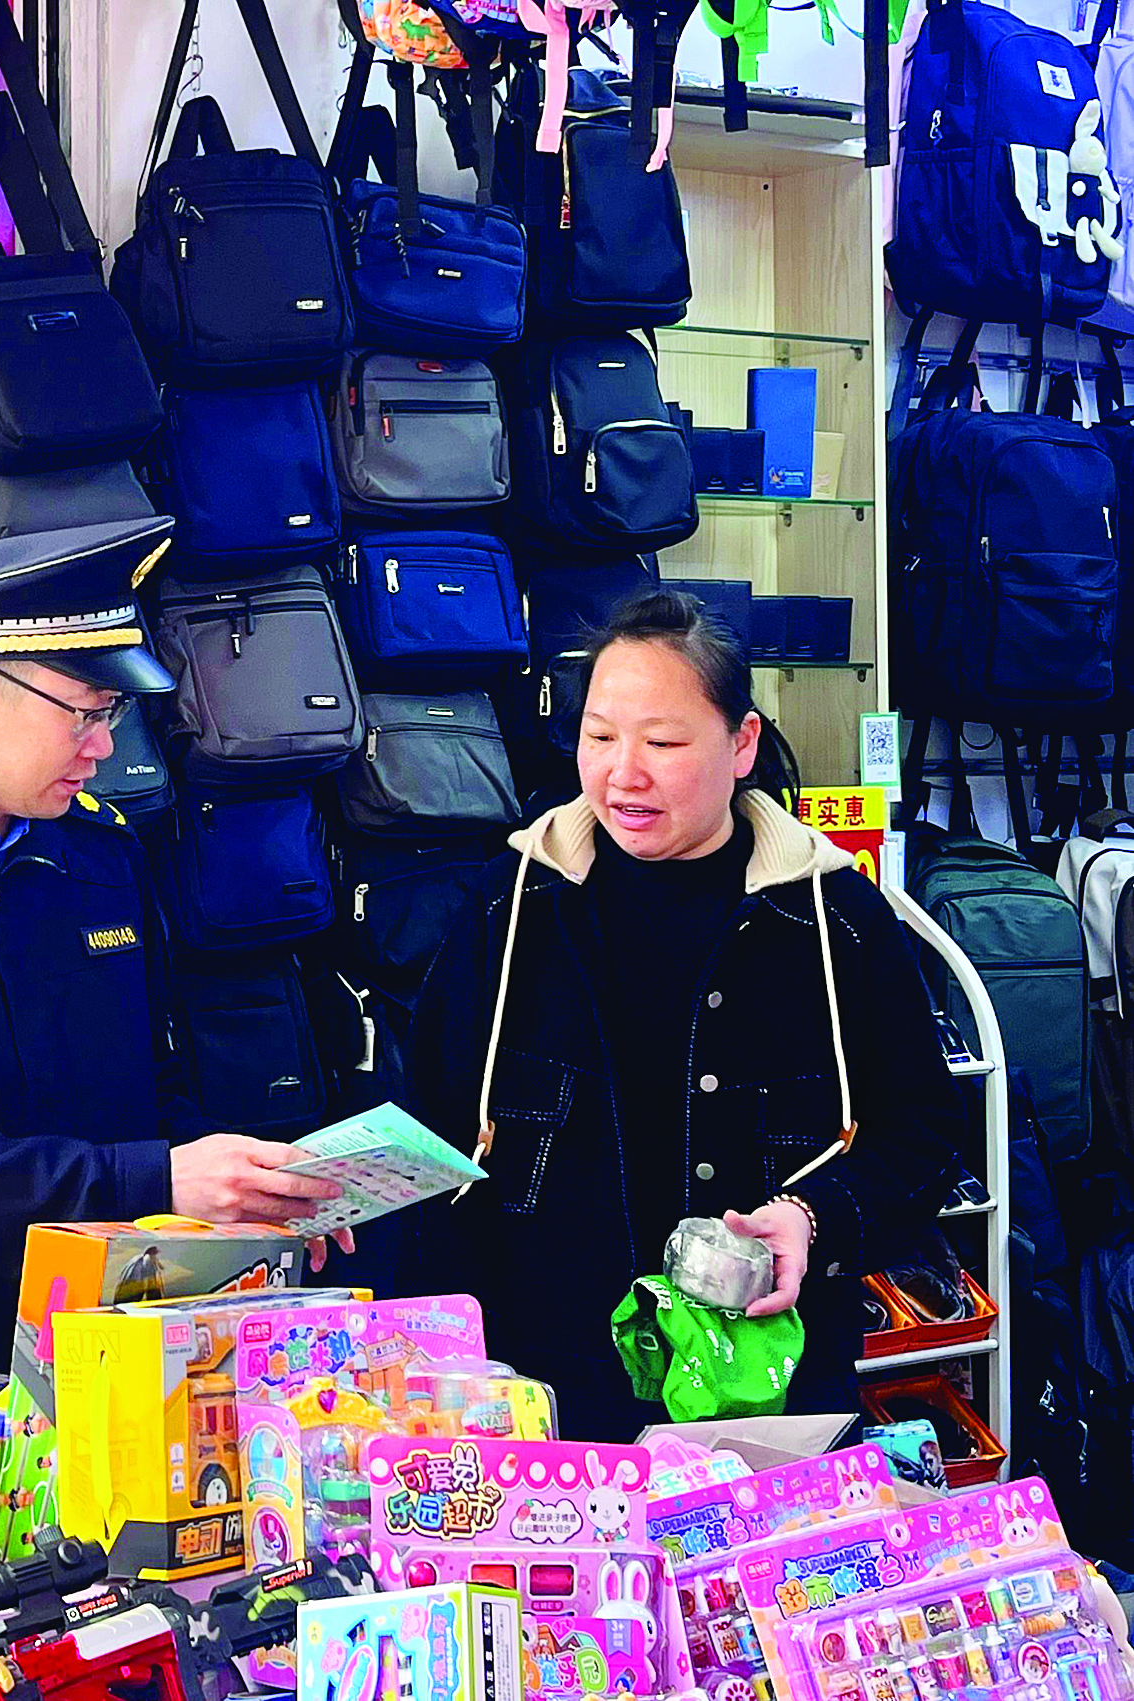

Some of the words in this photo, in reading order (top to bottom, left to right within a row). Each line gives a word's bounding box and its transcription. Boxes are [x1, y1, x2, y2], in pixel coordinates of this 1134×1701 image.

[88, 926, 136, 950] 44090148
[388, 1490, 495, 1535] 乐园超市
[175, 1518, 223, 1564] 电动
